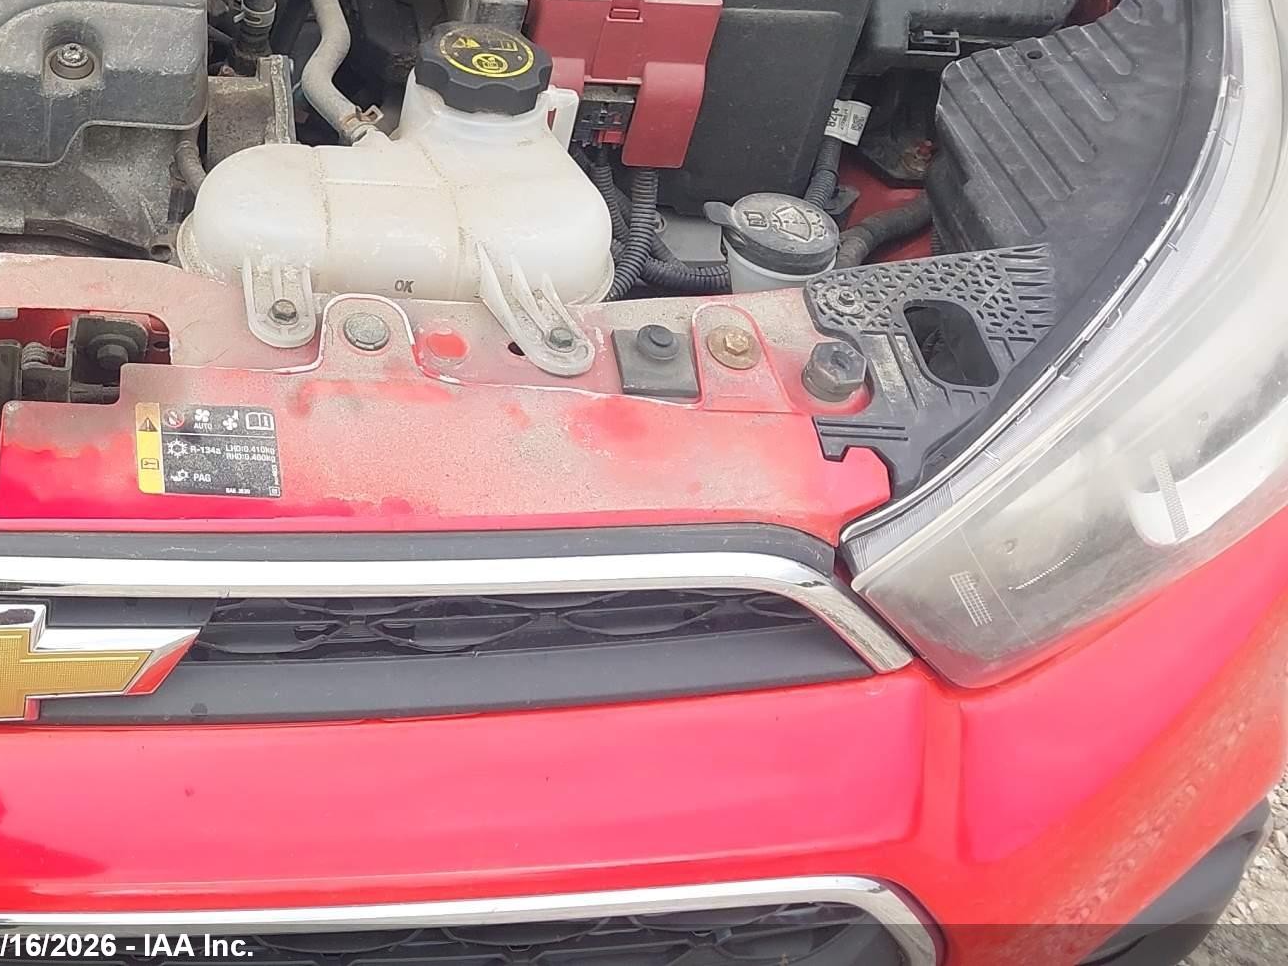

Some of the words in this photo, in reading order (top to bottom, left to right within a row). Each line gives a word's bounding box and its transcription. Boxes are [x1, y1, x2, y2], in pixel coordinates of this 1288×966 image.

[395, 280, 415, 293] OK
[190, 445, 221, 455] R-134a
[193, 474, 212, 482] PAG
